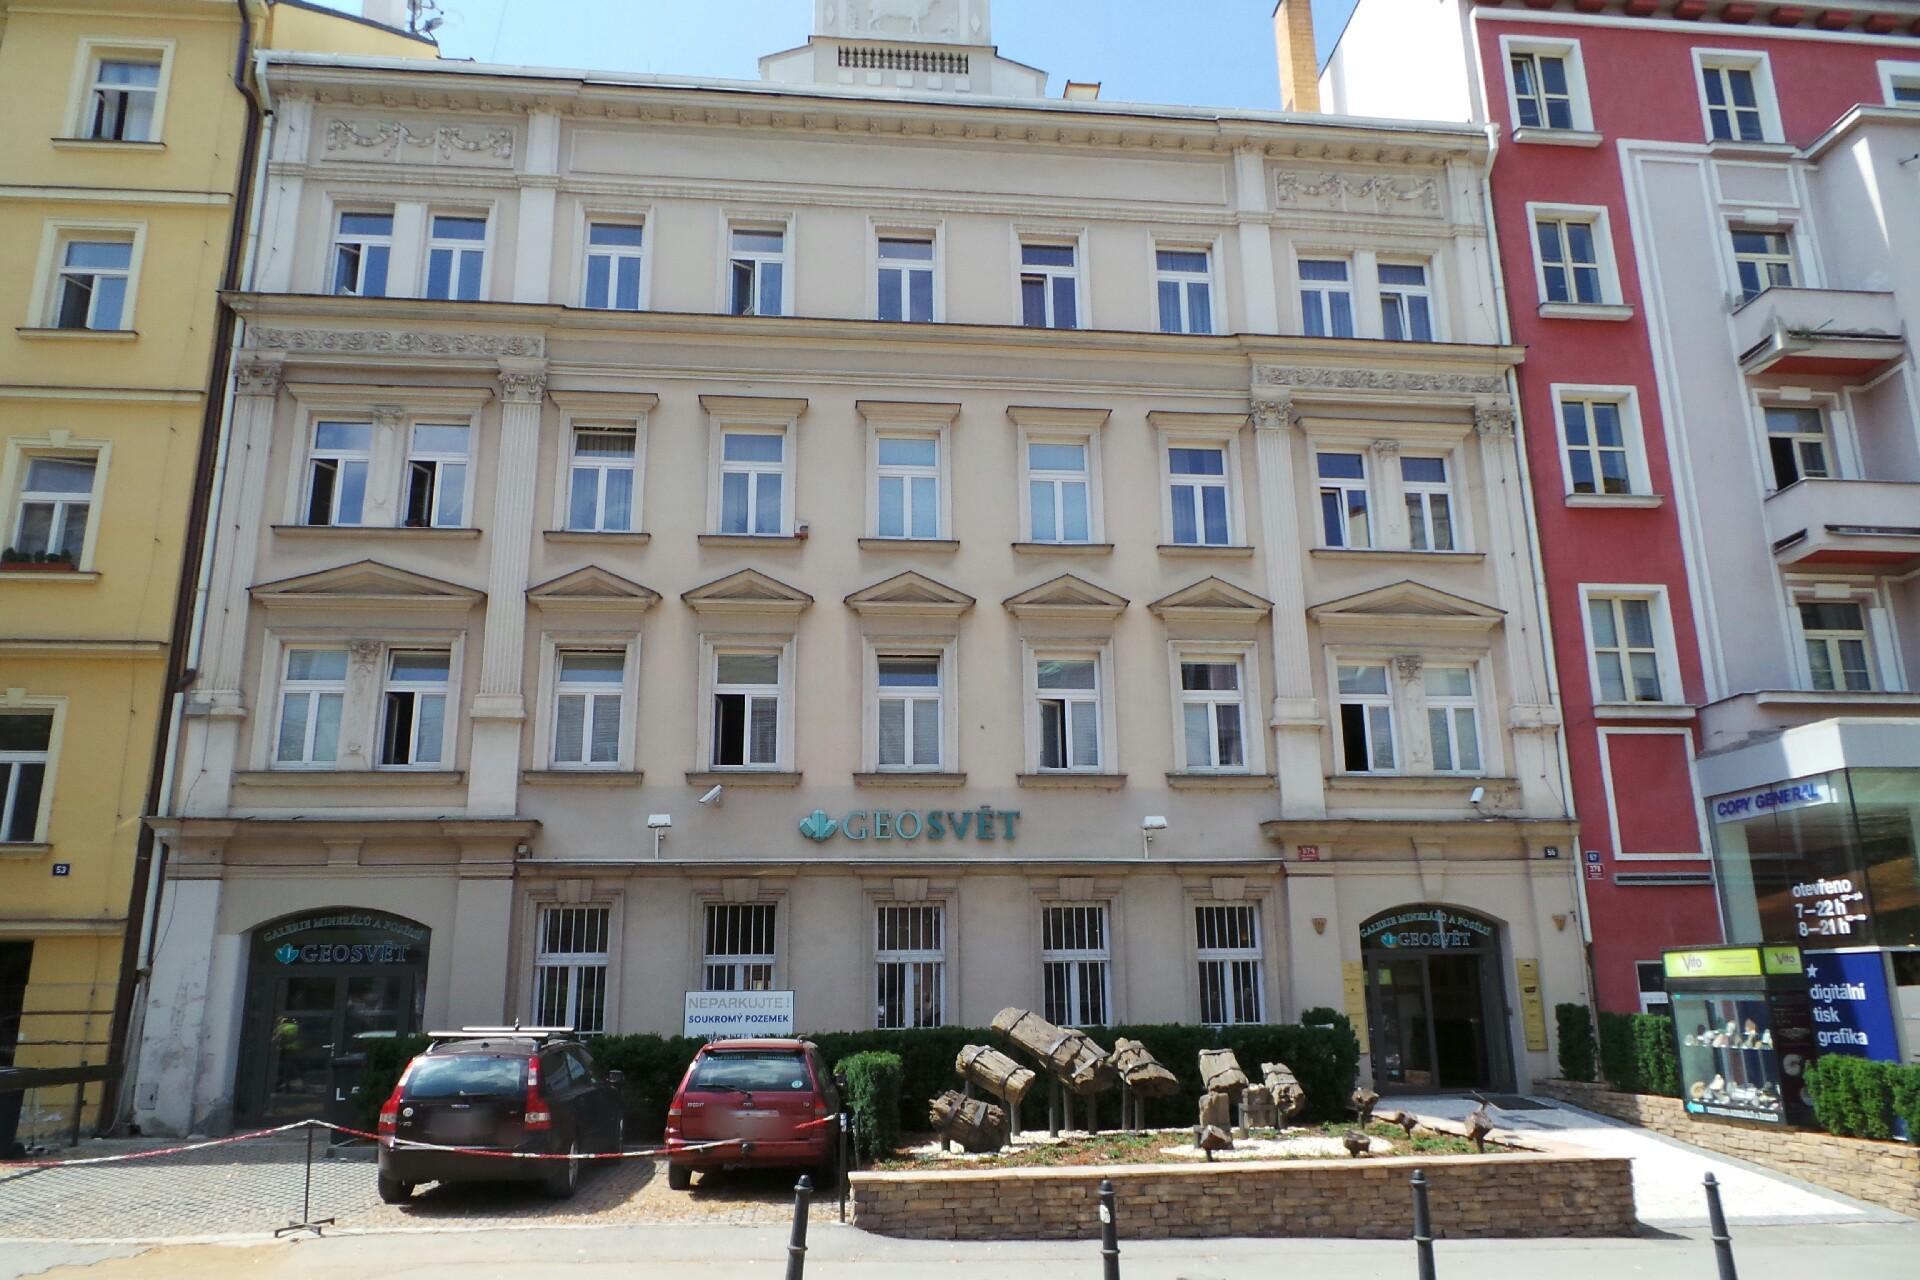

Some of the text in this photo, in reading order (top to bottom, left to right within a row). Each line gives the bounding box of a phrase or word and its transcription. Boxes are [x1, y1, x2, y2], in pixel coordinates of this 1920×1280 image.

[1717, 783, 1819, 816] COPY GENERAL
[843, 805, 1020, 840] GEOSVĚT
[1792, 878, 1852, 898] otevřeno
[1810, 982, 1866, 1003] digitální
[688, 997, 784, 1009] NEPARKUJTE
[688, 1013, 789, 1024] SOUKROMÝ POZEMEK
[1813, 1006, 1840, 1022] tisk
[1818, 1027, 1869, 1047] grafika
